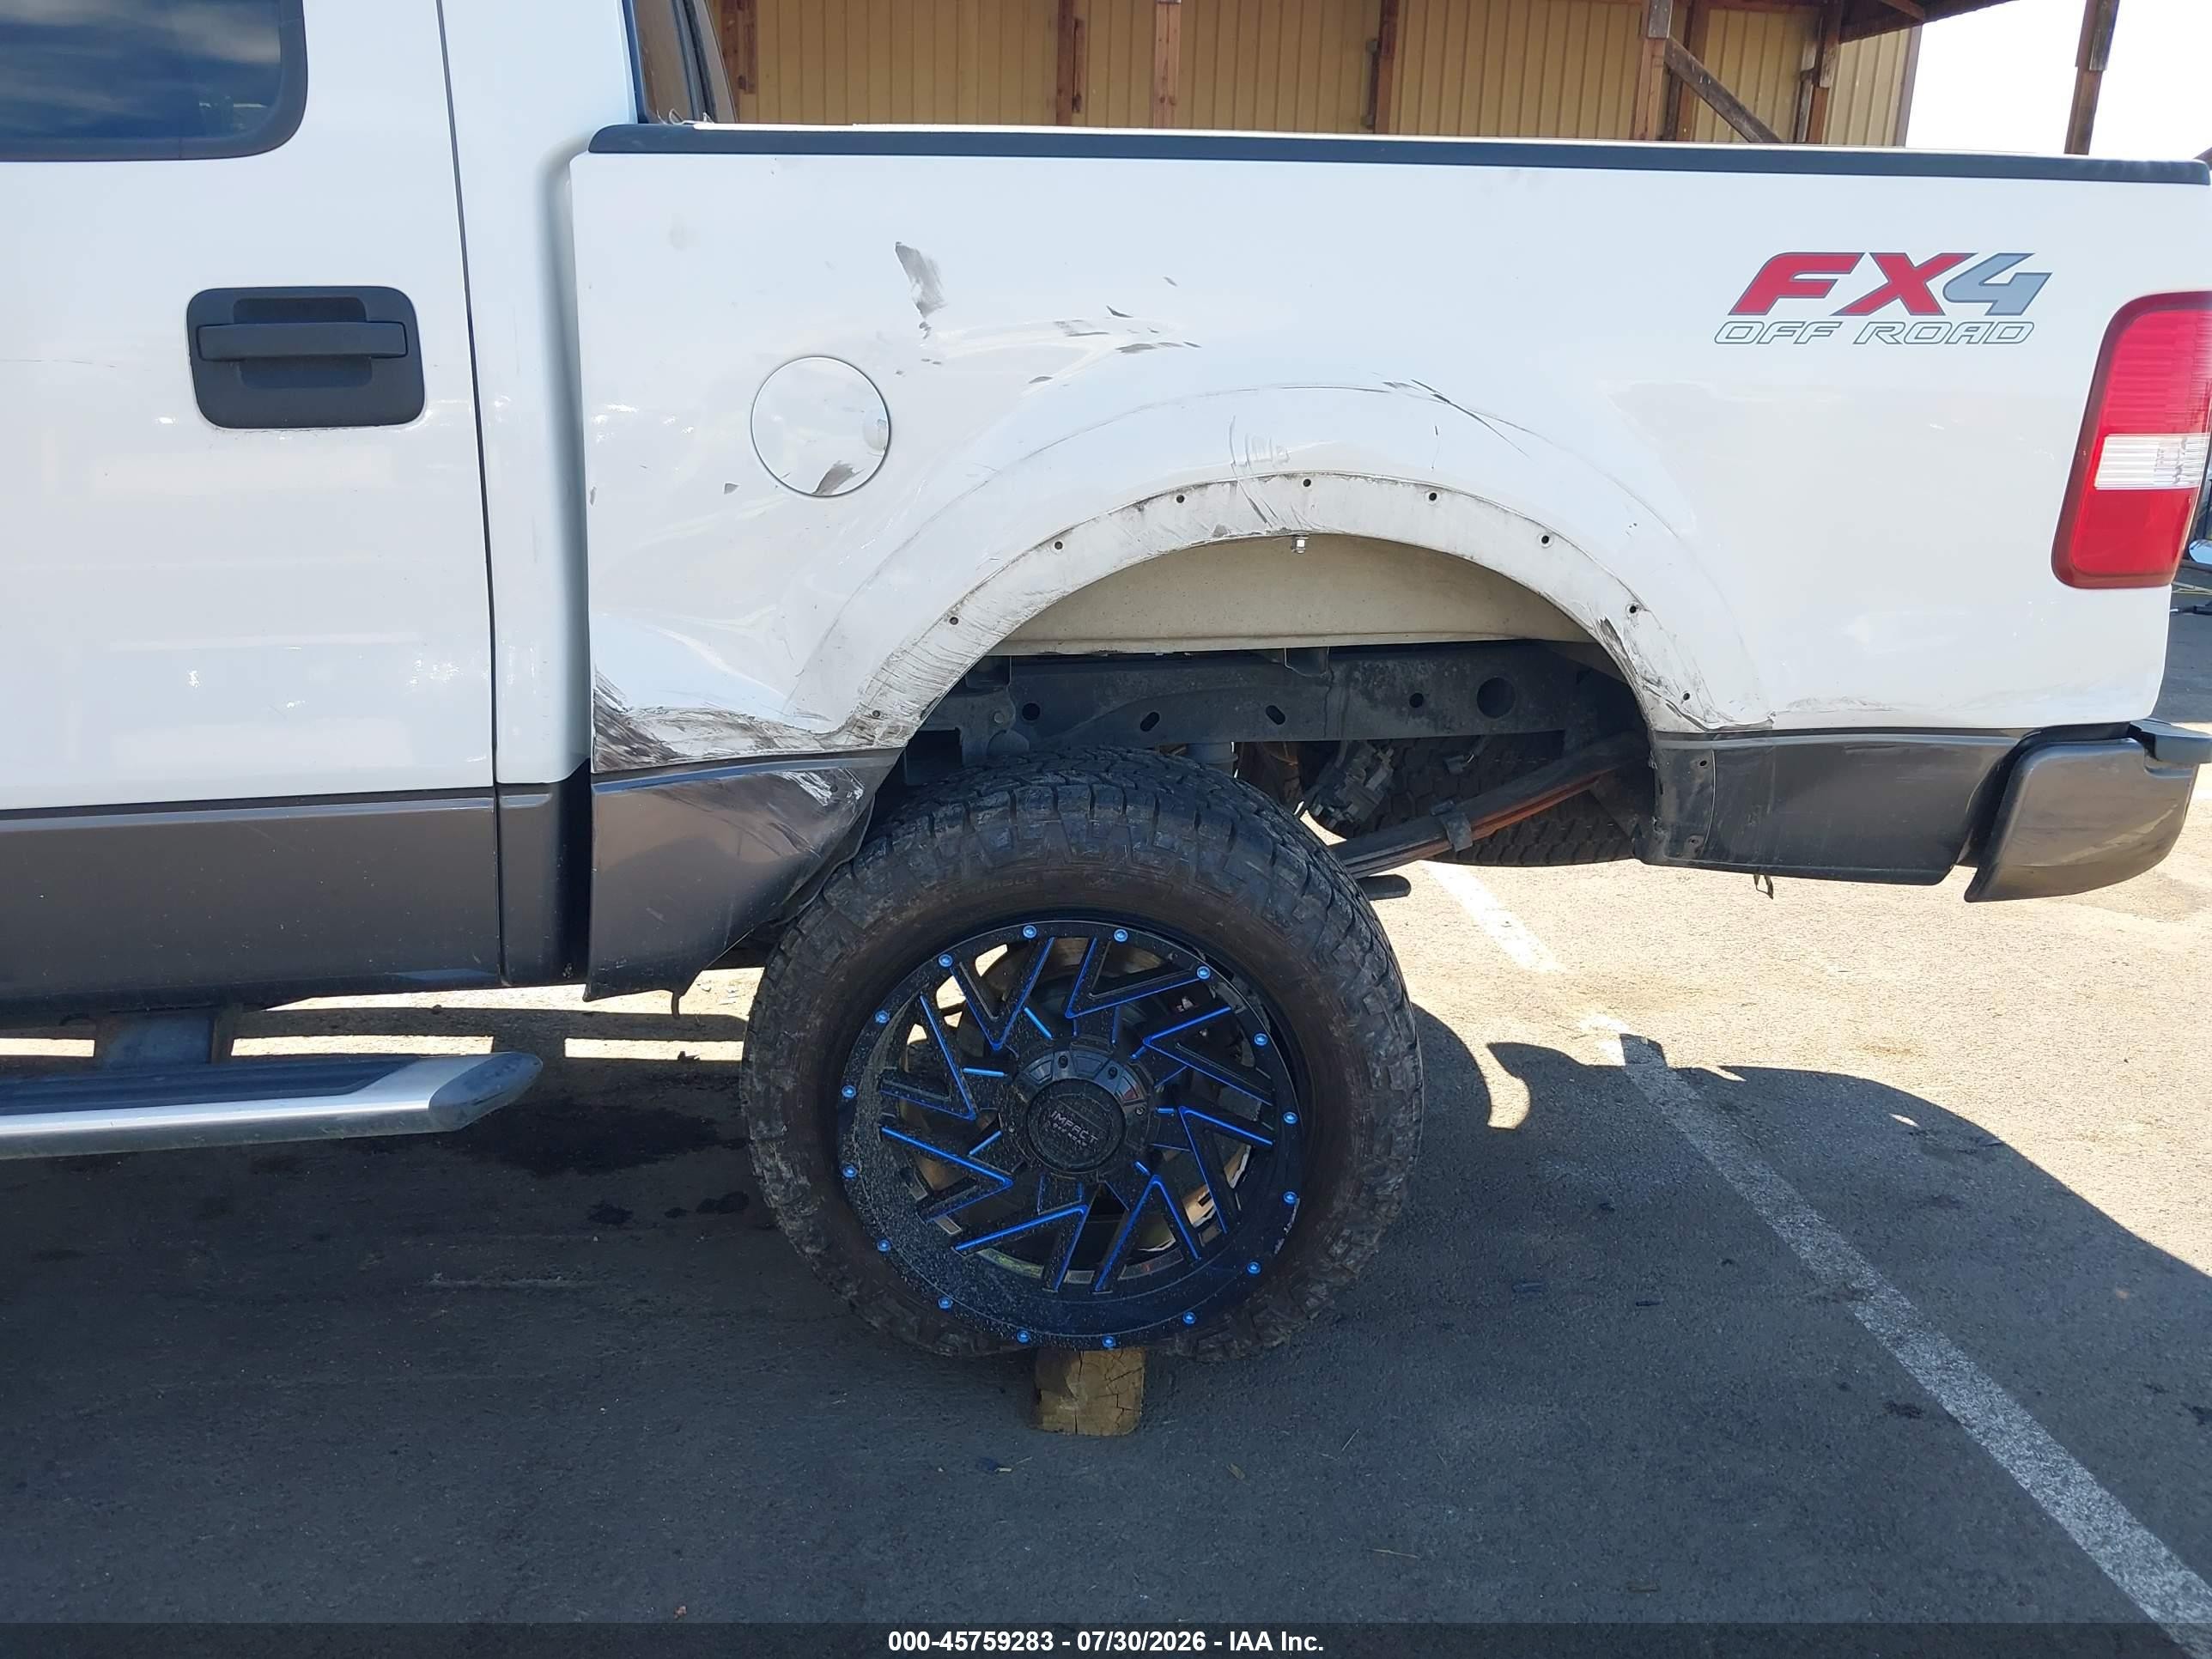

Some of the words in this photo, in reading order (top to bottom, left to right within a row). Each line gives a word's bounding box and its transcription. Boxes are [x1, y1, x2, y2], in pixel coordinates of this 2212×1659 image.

[1728, 252, 2052, 316] FX4
[1714, 320, 1843, 344] OFF
[1852, 320, 2035, 344] ROAD
[1050, 1110, 1098, 1143] IMPACT
